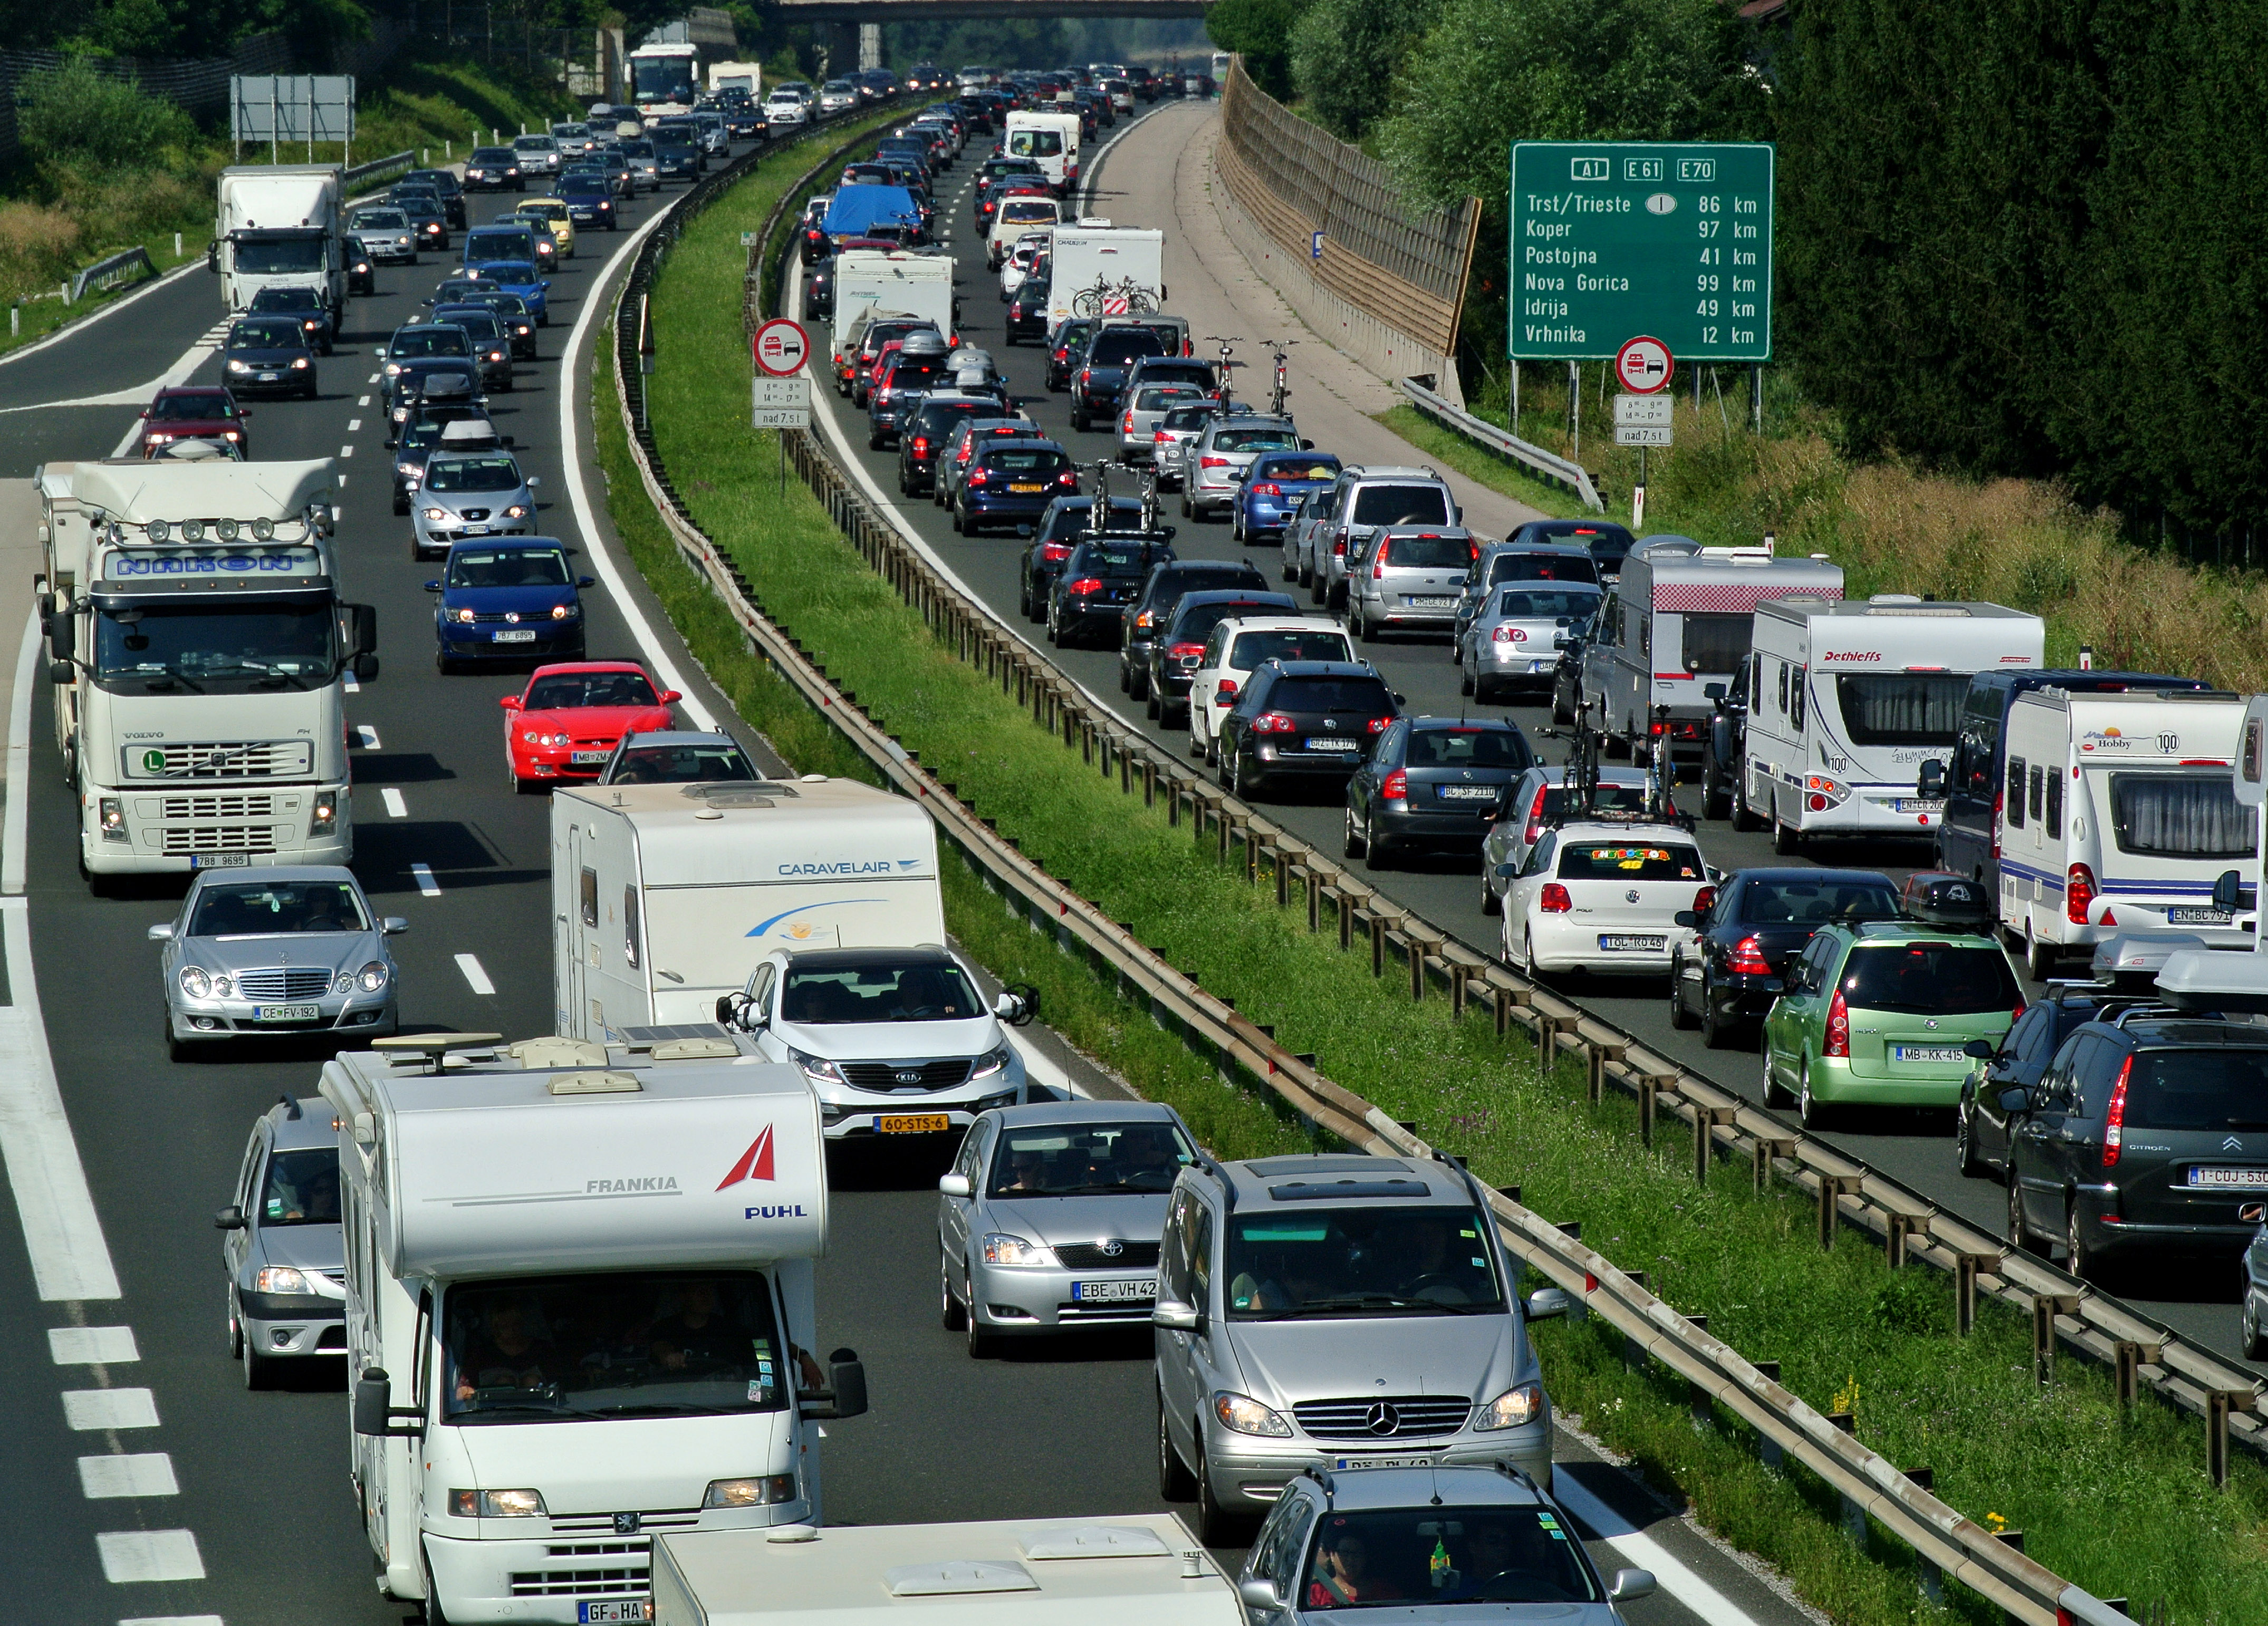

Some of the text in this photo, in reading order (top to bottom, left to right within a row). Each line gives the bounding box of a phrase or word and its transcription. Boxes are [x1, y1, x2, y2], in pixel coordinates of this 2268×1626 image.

[1582, 162, 1599, 176] A1
[1629, 162, 1659, 177] E 61
[1682, 163, 1710, 177] E 70
[1527, 192, 1631, 215] Trst/Trieste
[1699, 196, 1720, 213] 86
[1735, 196, 1757, 214] km
[1526, 219, 1757, 241] Koper 97 km
[1526, 246, 1756, 268] Postojna 41 km
[1525, 273, 1755, 292] Nova Gorica 99 km
[1525, 298, 1755, 319] Idrija 49 km
[1525, 325, 1754, 343] Vrhnika 12 km
[763, 414, 779, 423] nad
[797, 414, 800, 423] t
[1625, 431, 1641, 441] nad
[1659, 431, 1662, 441] t
[1824, 651, 1882, 662] Dethleffs
[2098, 740, 2131, 750] Hobby
[2158, 734, 2177, 749] 100
[148, 754, 159, 769] L
[1830, 757, 1847, 770] 100
[1462, 787, 1473, 796] SF
[1901, 800, 1913, 809] EN
[1917, 800, 1927, 809] CR
[222, 855, 244, 865] 9695
[1592, 849, 1670, 861] THE DOCTOR
[779, 861, 890, 875] CARAVELAIR
[2175, 910, 2188, 920] EN
[2195, 910, 2208, 920] BC
[1609, 937, 1628, 946] TÖL
[1649, 938, 1662, 947] 46
[263, 1008, 276, 1018] CE
[1905, 1048, 1920, 1059] MB
[885, 1117, 943, 1130] 60-STS-6
[587, 1177, 678, 1193] FRANKIA
[745, 1204, 808, 1220] PUHL
[1081, 1282, 1157, 1297] EBE VH 42
[590, 1603, 640, 1620] GF HA
